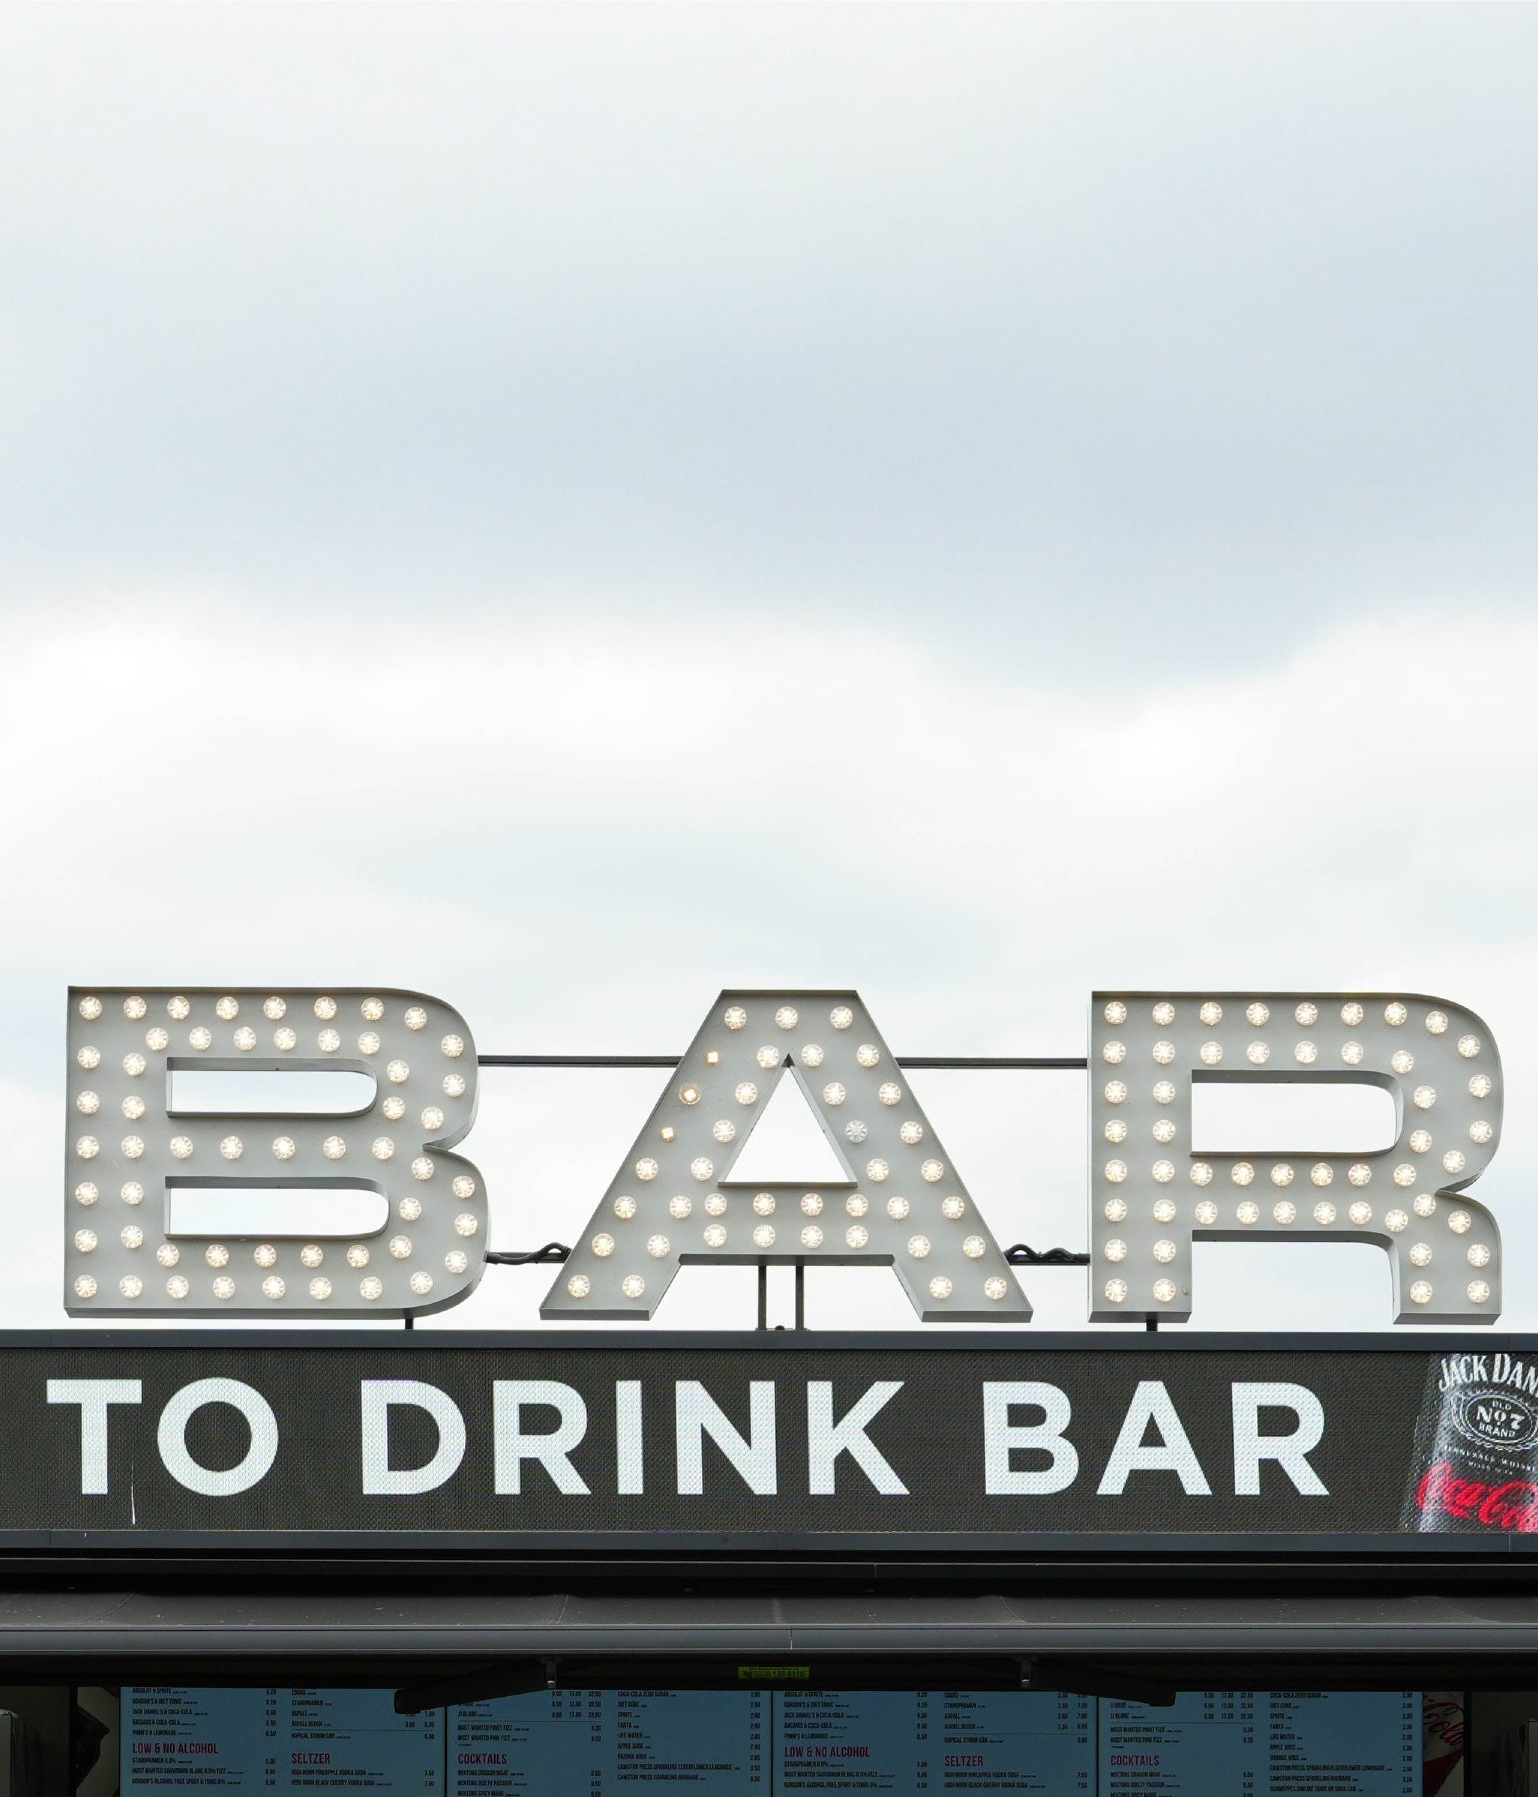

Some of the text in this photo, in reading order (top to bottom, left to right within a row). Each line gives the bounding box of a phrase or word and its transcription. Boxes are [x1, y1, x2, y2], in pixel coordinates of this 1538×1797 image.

[64, 986, 1503, 1320] BAR
[1438, 1354, 1489, 1392] JACK
[1478, 1422, 1516, 1438] BRAND
[46, 1378, 280, 1497] TO
[361, 1377, 908, 1496] DRINK
[982, 1376, 1330, 1494] BAR
[132, 1742, 219, 1754] LOW & NO ALCOHOL
[783, 1746, 871, 1758] LOW & NO ALCOHOL
[291, 1752, 330, 1764] SELTZER
[457, 1753, 508, 1765] COCKTAILS
[944, 1755, 984, 1767] SELTZER
[1110, 1755, 1160, 1766] COCKTAILS
